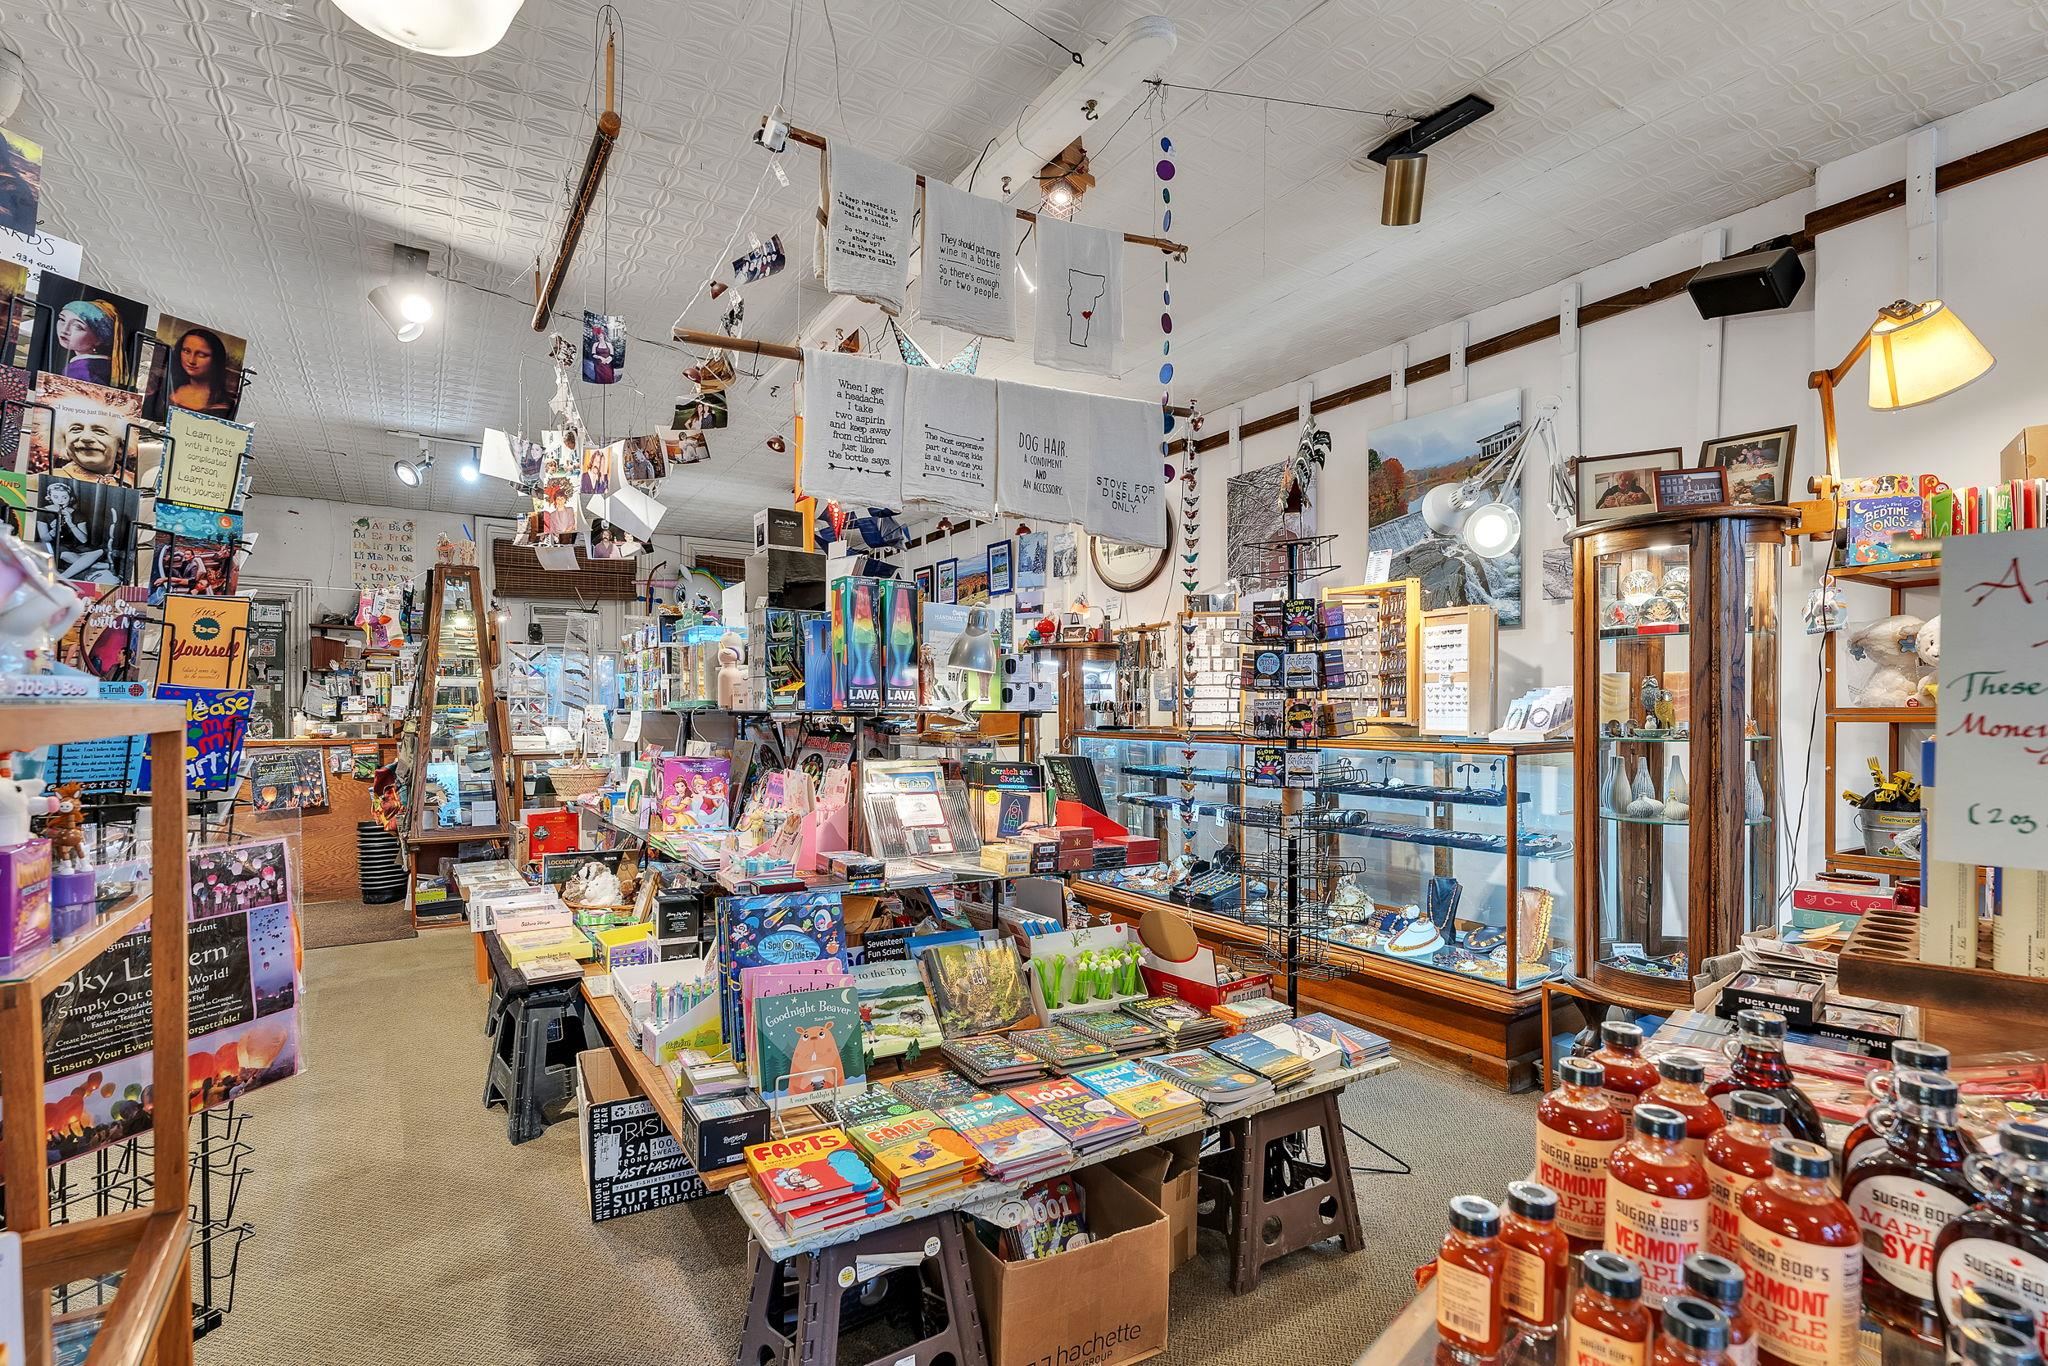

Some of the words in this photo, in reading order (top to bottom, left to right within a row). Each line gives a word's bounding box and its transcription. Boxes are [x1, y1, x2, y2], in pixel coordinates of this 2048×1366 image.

[864, 209, 889, 220] village
[855, 228, 869, 237] they
[872, 233, 886, 241] just
[842, 248, 866, 259] number
[858, 244, 876, 254] there
[941, 233, 957, 247] They
[958, 238, 975, 251] should
[976, 246, 985, 254] put
[986, 249, 1000, 259] more
[940, 246, 958, 256] wine
[961, 250, 967, 259] in
[977, 255, 1002, 270] bottle.
[939, 264, 947, 274] So
[950, 267, 974, 281] there's
[976, 276, 1000, 290] enough
[940, 275, 952, 286] for
[957, 280, 970, 291] two
[974, 286, 1002, 300] people.
[838, 378, 862, 392] When
[871, 387, 884, 395] get
[854, 404, 873, 413] take
[835, 411, 852, 420] two
[856, 415, 885, 425] aspirin
[186, 426, 212, 443] Learn
[215, 434, 223, 444] to
[225, 437, 236, 447] live
[829, 421, 846, 430] and
[850, 422, 867, 434] keep
[869, 427, 891, 436] away
[833, 430, 851, 441] from
[925, 432, 938, 440] The
[185, 441, 202, 451] with
[212, 446, 232, 458] most
[841, 442, 857, 452] just
[860, 445, 874, 454] like
[1019, 432, 1039, 452] DOG
[1044, 438, 1068, 458] HAIR.
[187, 453, 227, 467] complicated
[828, 450, 842, 459] the
[845, 452, 868, 463] bottle
[871, 457, 891, 466] says.
[1024, 454, 1028, 463] A
[1030, 456, 1062, 469] CONDIMENT
[190, 464, 218, 478] person
[924, 463, 945, 472] have
[1035, 469, 1047, 480] AND
[178, 472, 204, 486] Learn
[207, 479, 215, 487] to
[1023, 479, 1031, 489] AN
[1033, 481, 1064, 496] ACCESSORY.
[1096, 476, 1128, 491] STOVE
[1135, 484, 1156, 495] FOR
[174, 484, 191, 494] with
[193, 488, 227, 502] yourself
[1102, 487, 1148, 504] DISPLAY
[1111, 500, 1139, 514] ONLY.
[1863, 506, 1909, 522] BEDTIME
[1864, 516, 1906, 537] SONGS
[108, 685, 125, 693] Truth
[1946, 670, 2048, 702] These
[849, 689, 879, 700] LAVA
[888, 690, 916, 700] LAVA
[990, 766, 1018, 776] Scratch
[999, 775, 1025, 784] Sketch
[768, 942, 780, 950] Spy
[867, 938, 904, 949] Seventeen
[868, 950, 881, 958] Fun
[870, 969, 885, 978] the
[887, 967, 907, 977] Top
[54, 968, 113, 999] Sky
[58, 1000, 110, 1019] Simply
[113, 991, 144, 1005] Out
[188, 967, 229, 986] World!
[1738, 997, 1766, 1007] FUCK
[1768, 1002, 1800, 1014] YEAH!
[83, 1012, 103, 1023] 100%
[91, 1018, 118, 1029] Factory
[120, 1009, 144, 1021] Tested!
[765, 1001, 816, 1028] Goodnight
[819, 1000, 851, 1015] Beaver
[55, 1036, 79, 1047] Create
[81, 1028, 113, 1041] Dreamlike
[114, 1020, 142, 1031] Displays
[52, 1057, 94, 1075] Ensure
[95, 1048, 122, 1064] Your
[1094, 1077, 1121, 1087] You
[1027, 1088, 1081, 1104] 1001
[978, 1106, 1017, 1118] Book
[1038, 1095, 1093, 1114] Jokes
[1061, 1112, 1107, 1128] Kids
[867, 1117, 935, 1144] FARTS
[753, 1136, 840, 1161] FARTS
[1541, 1140, 1570, 1163] SUGAR
[1574, 1155, 1608, 1169] BOB'S
[602, 1190, 610, 1207] THE
[613, 1178, 702, 1208] SUPERIOR
[613, 1202, 648, 1217] PRINT
[1872, 1189, 1919, 1214] SUGAR
[1616, 1200, 1656, 1227] SUGAR
[1660, 1215, 1699, 1232] BOB'S
[1780, 1256, 1830, 1282] BOB'S
[1964, 1253, 2015, 1286] SUGAR
[1057, 1323, 1141, 1366] hachette
